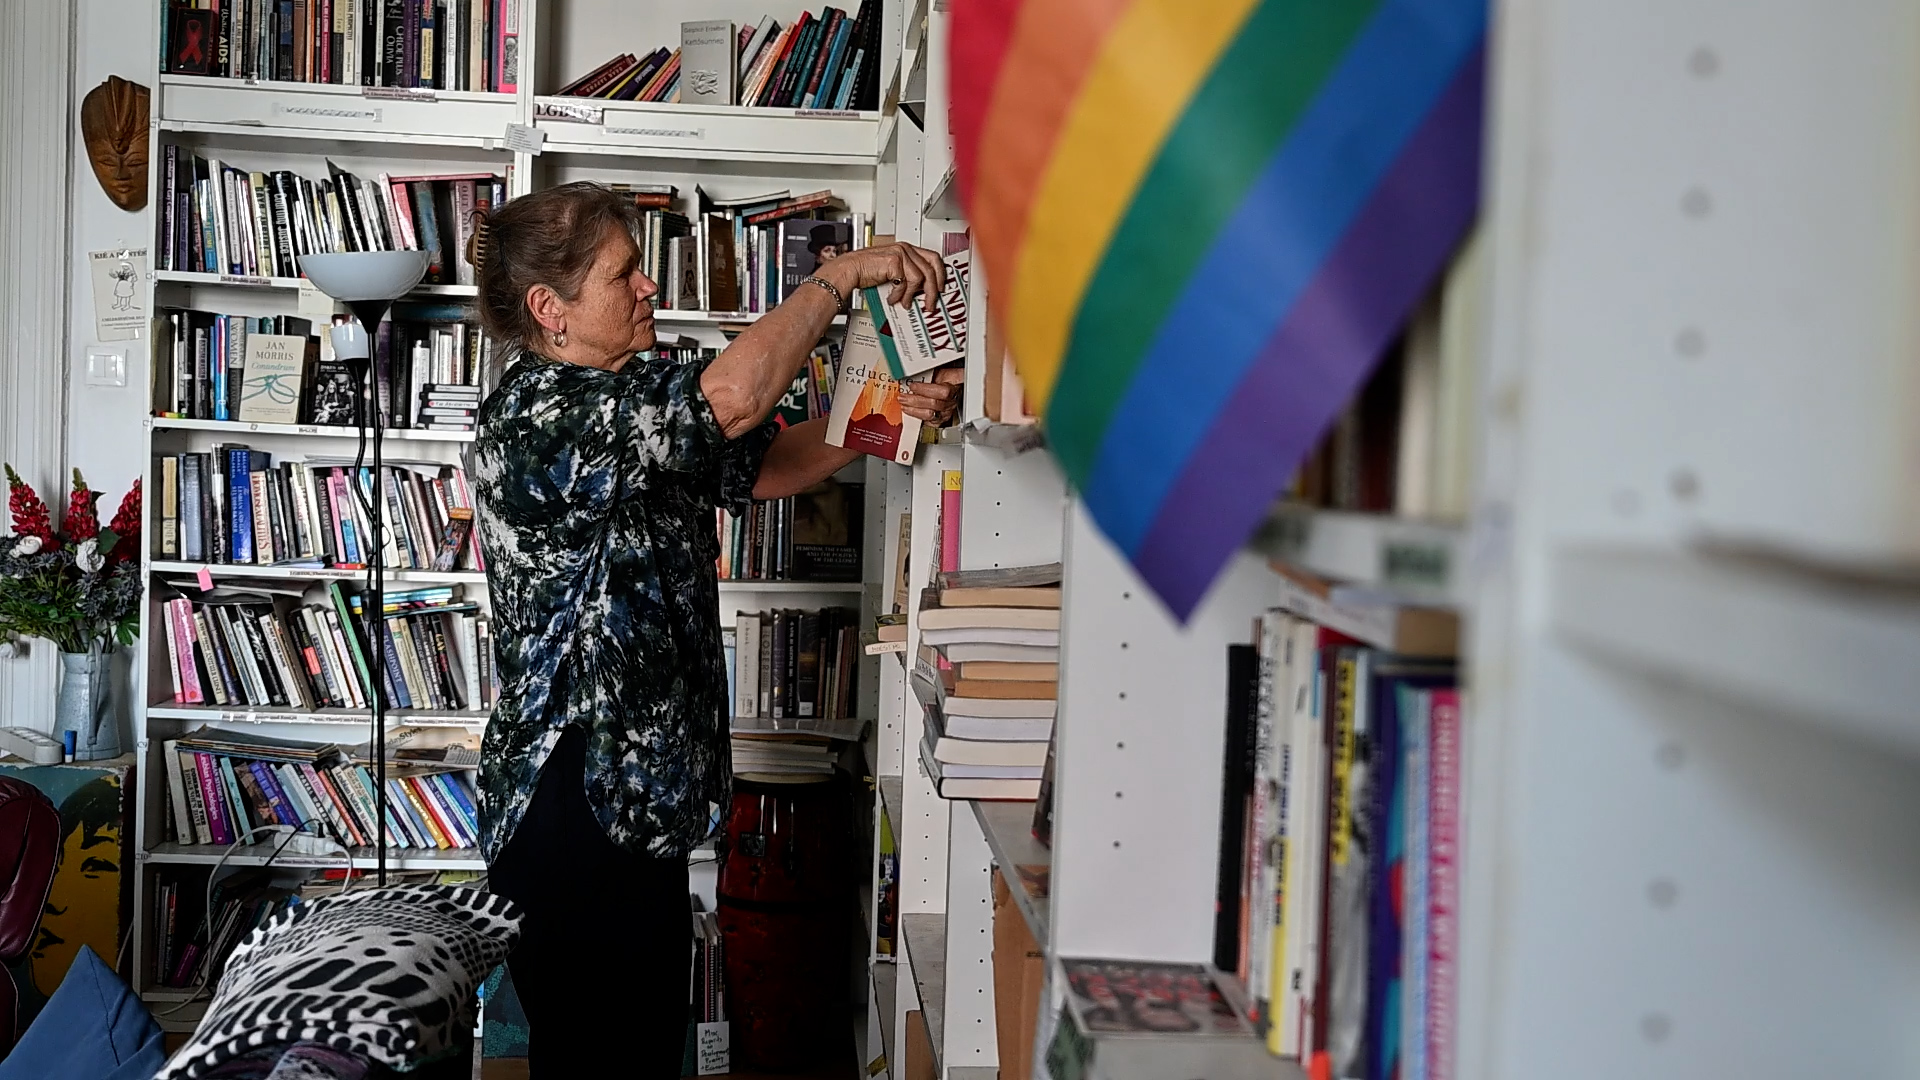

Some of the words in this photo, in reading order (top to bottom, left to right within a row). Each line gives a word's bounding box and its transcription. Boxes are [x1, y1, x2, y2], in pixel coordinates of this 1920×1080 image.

[218, 8, 230, 36] Writing
[218, 35, 229, 64] AIDS
[385, 35, 395, 64] OLIVIA
[395, 25, 405, 54] CHLOE
[395, 56, 404, 75] PLUS
[272, 192, 289, 225] Courting
[276, 225, 292, 255] Justice
[229, 322, 239, 365] WOMEN
[255, 350, 294, 361] MORRIS
[266, 341, 286, 350] JAN
[251, 362, 296, 372] Conundrum
[845, 376, 867, 386] TARA
[318, 478, 329, 512] COMING
[251, 474, 270, 550] HOMOSEXUALITIES
[322, 513, 332, 531] OUT
[755, 504, 765, 547] MASKERADO
[380, 634, 404, 684] FLASHPOINT
[762, 633, 770, 671] LOSER
[196, 752, 211, 780] Lesbian
[188, 767, 203, 800] COMBAT
[334, 770, 353, 796] Lesbian
[347, 792, 365, 815] Nation
[195, 799, 204, 809] IN
[201, 778, 222, 822] Psychologies
[197, 809, 208, 827] THE
